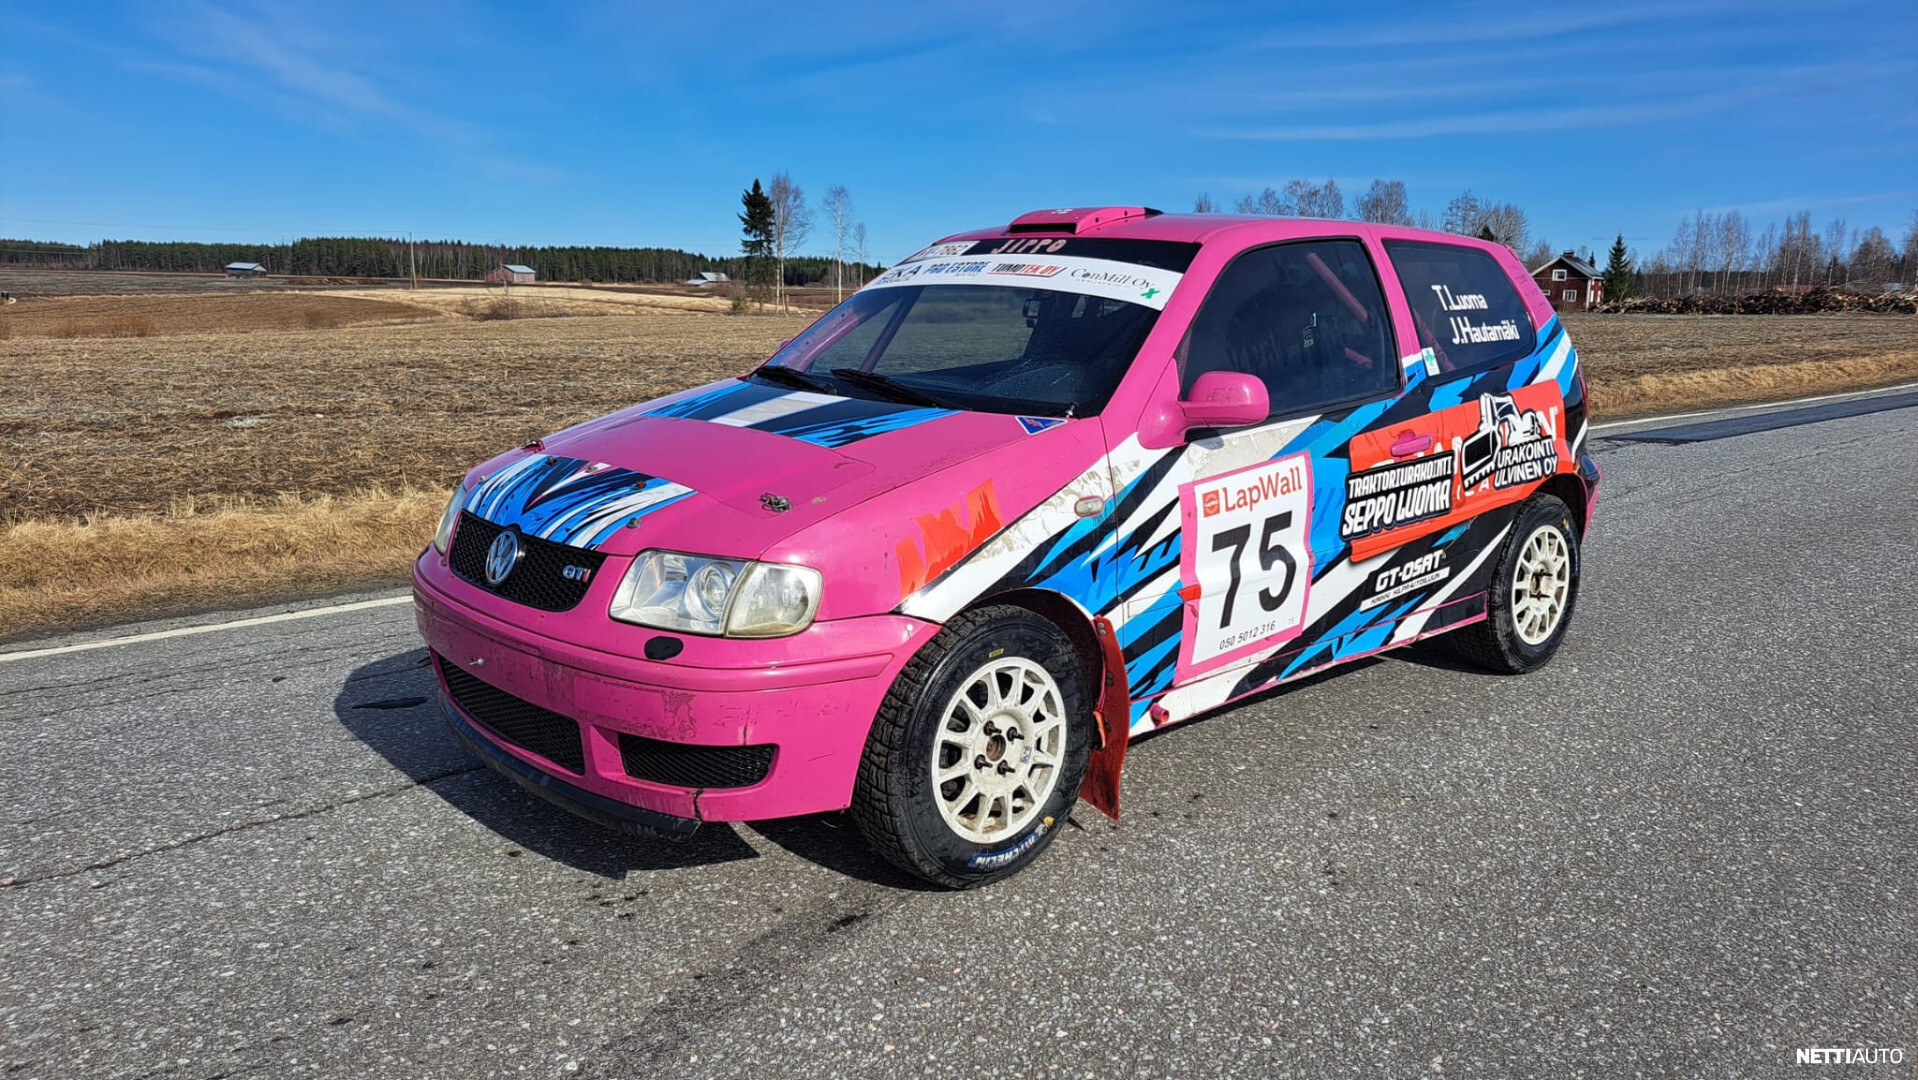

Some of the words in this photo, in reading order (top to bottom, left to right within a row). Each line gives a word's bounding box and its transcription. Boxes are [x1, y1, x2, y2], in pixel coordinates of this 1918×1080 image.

[990, 239, 1067, 254] JIPPO
[1071, 268, 1131, 285] ConMill
[1431, 284, 1488, 311] T.Luoma
[1449, 316, 1520, 344] J.Hautamäki
[1497, 438, 1555, 468] URAKOINTI
[1348, 455, 1453, 499] TRAKTORIURAKOINTI
[1494, 460, 1542, 487] ULVINEN
[1543, 455, 1558, 476] OY
[1222, 466, 1303, 512] LapWall
[1342, 492, 1397, 536] SEPPO
[1396, 479, 1452, 521] LUOMA
[1211, 509, 1297, 629] 75
[1219, 636, 1236, 650] 050
[1237, 626, 1259, 643] 5012
[1260, 619, 1276, 635] 316
